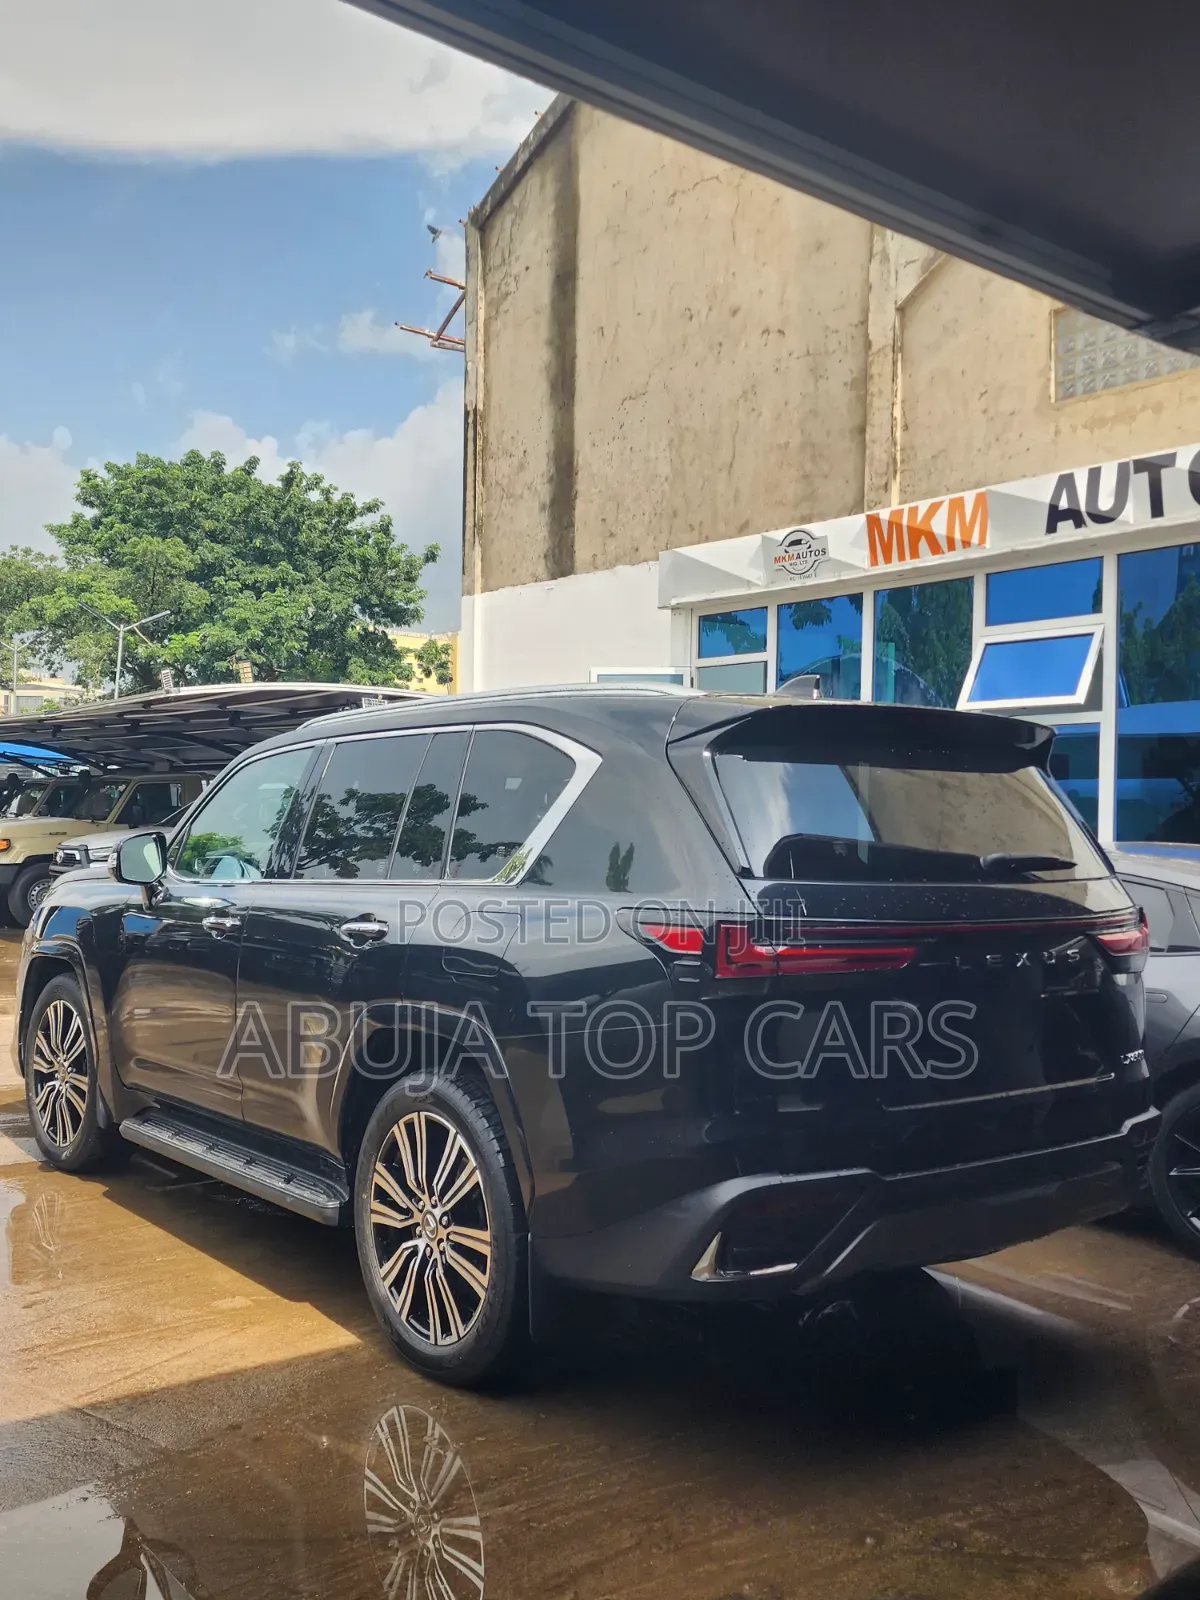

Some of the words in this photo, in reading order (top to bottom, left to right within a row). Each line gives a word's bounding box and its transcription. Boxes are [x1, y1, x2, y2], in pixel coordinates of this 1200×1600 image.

[865, 491, 988, 567] MKM
[1045, 449, 1200, 535] AUT
[954, 949, 1081, 969] LEXUS
